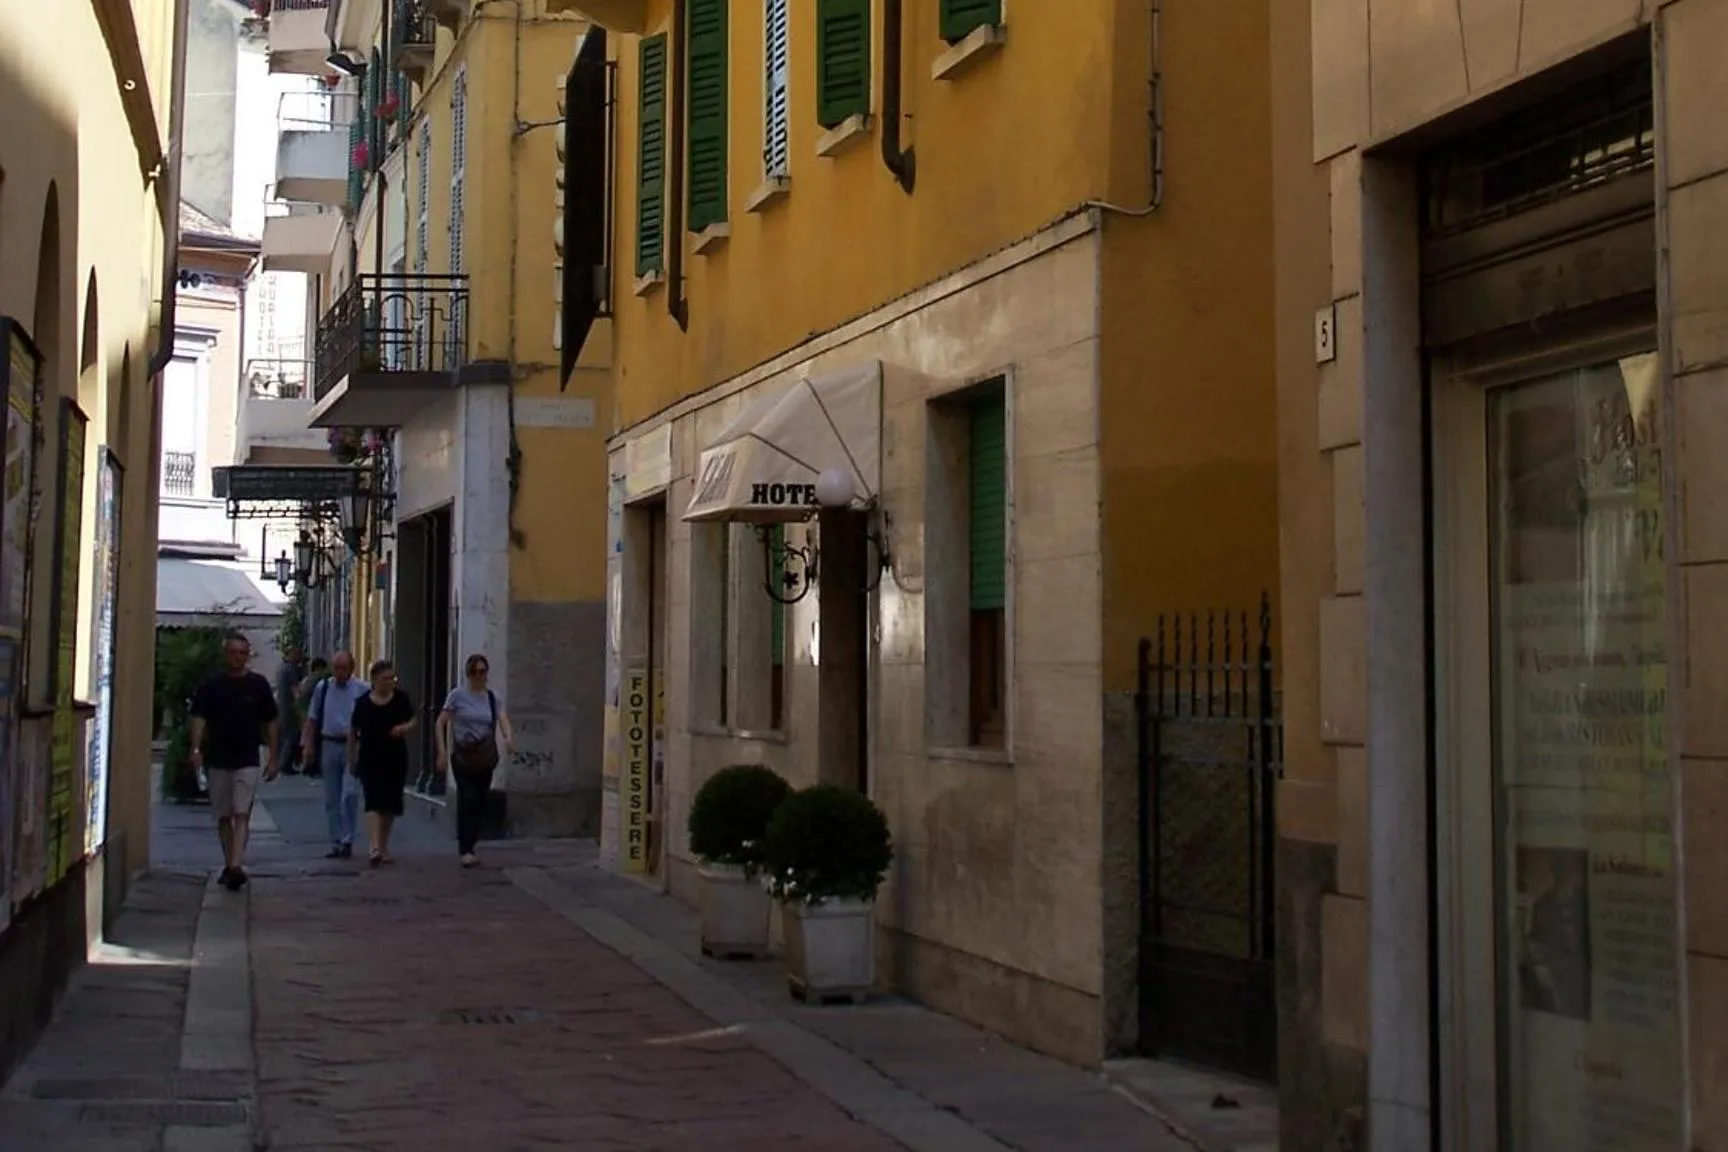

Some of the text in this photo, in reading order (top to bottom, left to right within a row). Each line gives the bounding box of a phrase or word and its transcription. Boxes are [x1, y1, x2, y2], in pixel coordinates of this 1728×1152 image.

[1320, 319, 1328, 348] 5
[752, 483, 822, 505] HOTE
[628, 676, 644, 860] FOTOTESSERE
